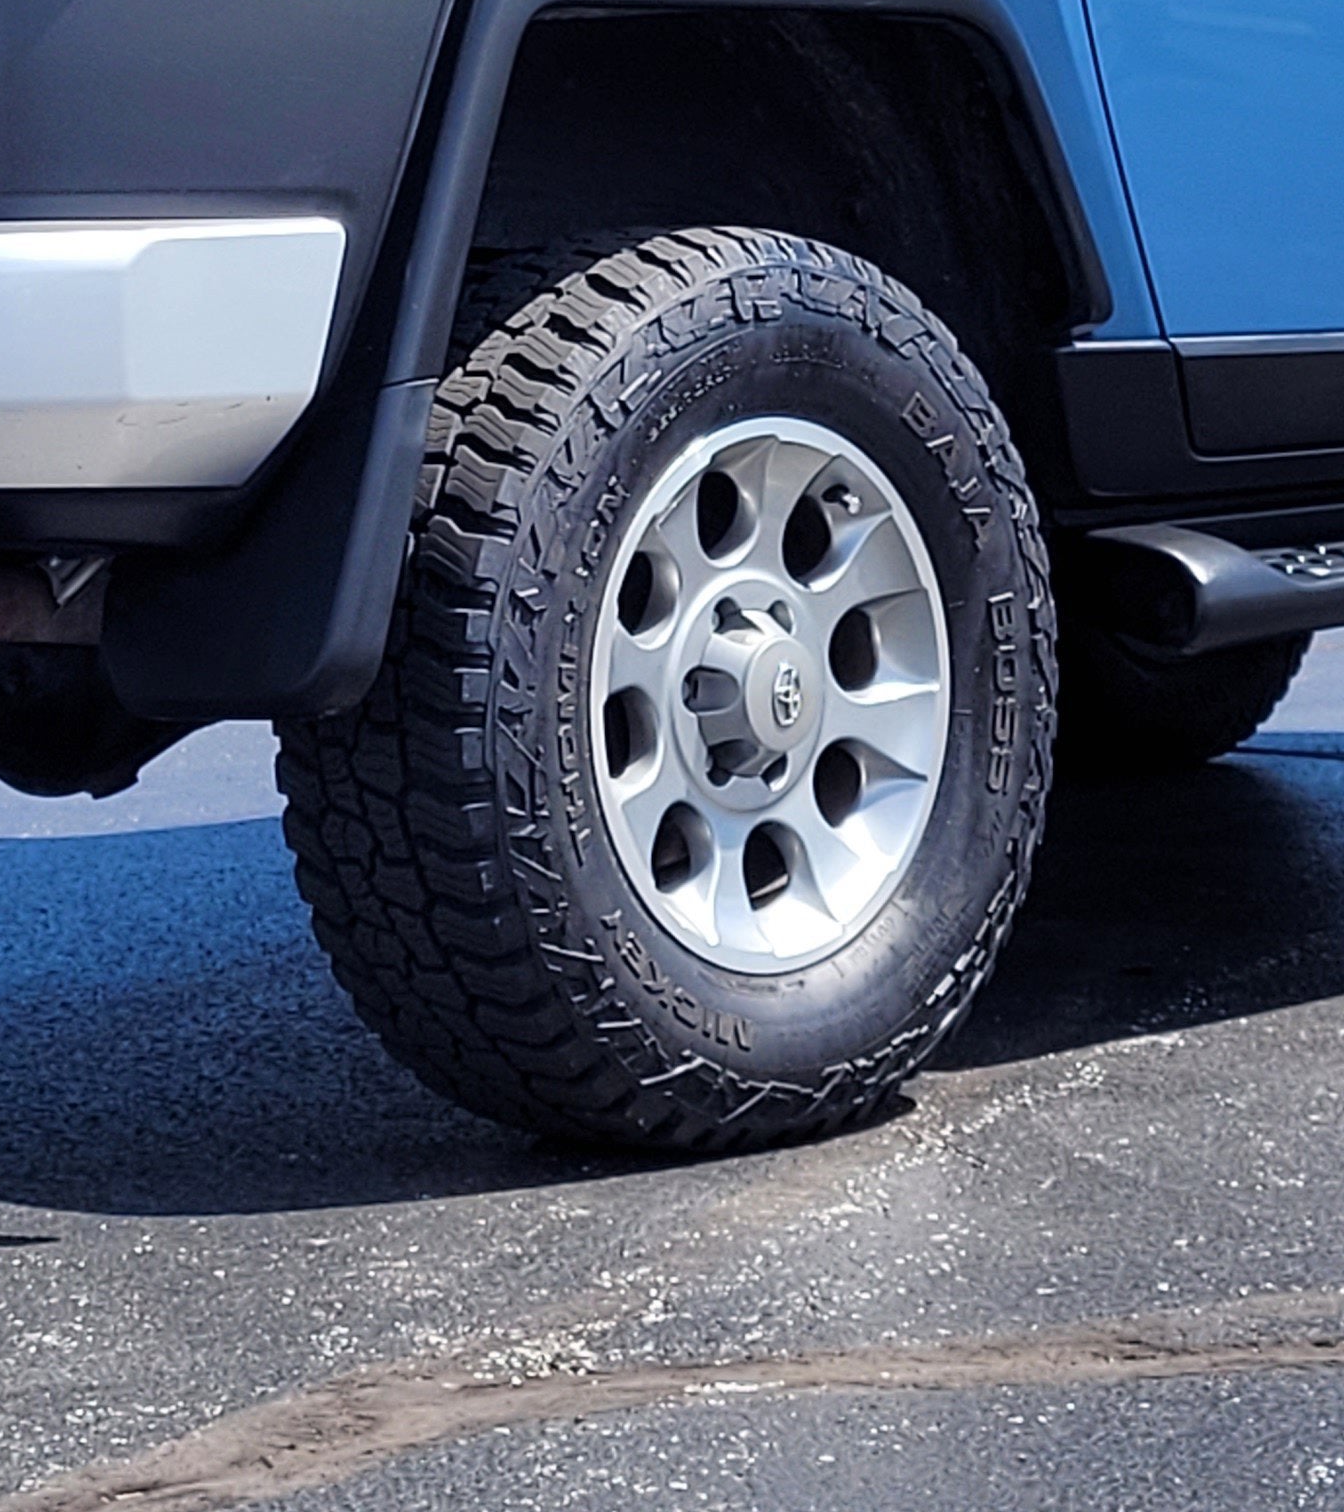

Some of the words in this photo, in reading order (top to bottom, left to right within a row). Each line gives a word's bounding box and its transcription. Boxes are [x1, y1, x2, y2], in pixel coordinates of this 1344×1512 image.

[900, 390, 996, 554] BAJA
[986, 591, 1020, 796] BOSS
[600, 908, 754, 1053] MICKEY
